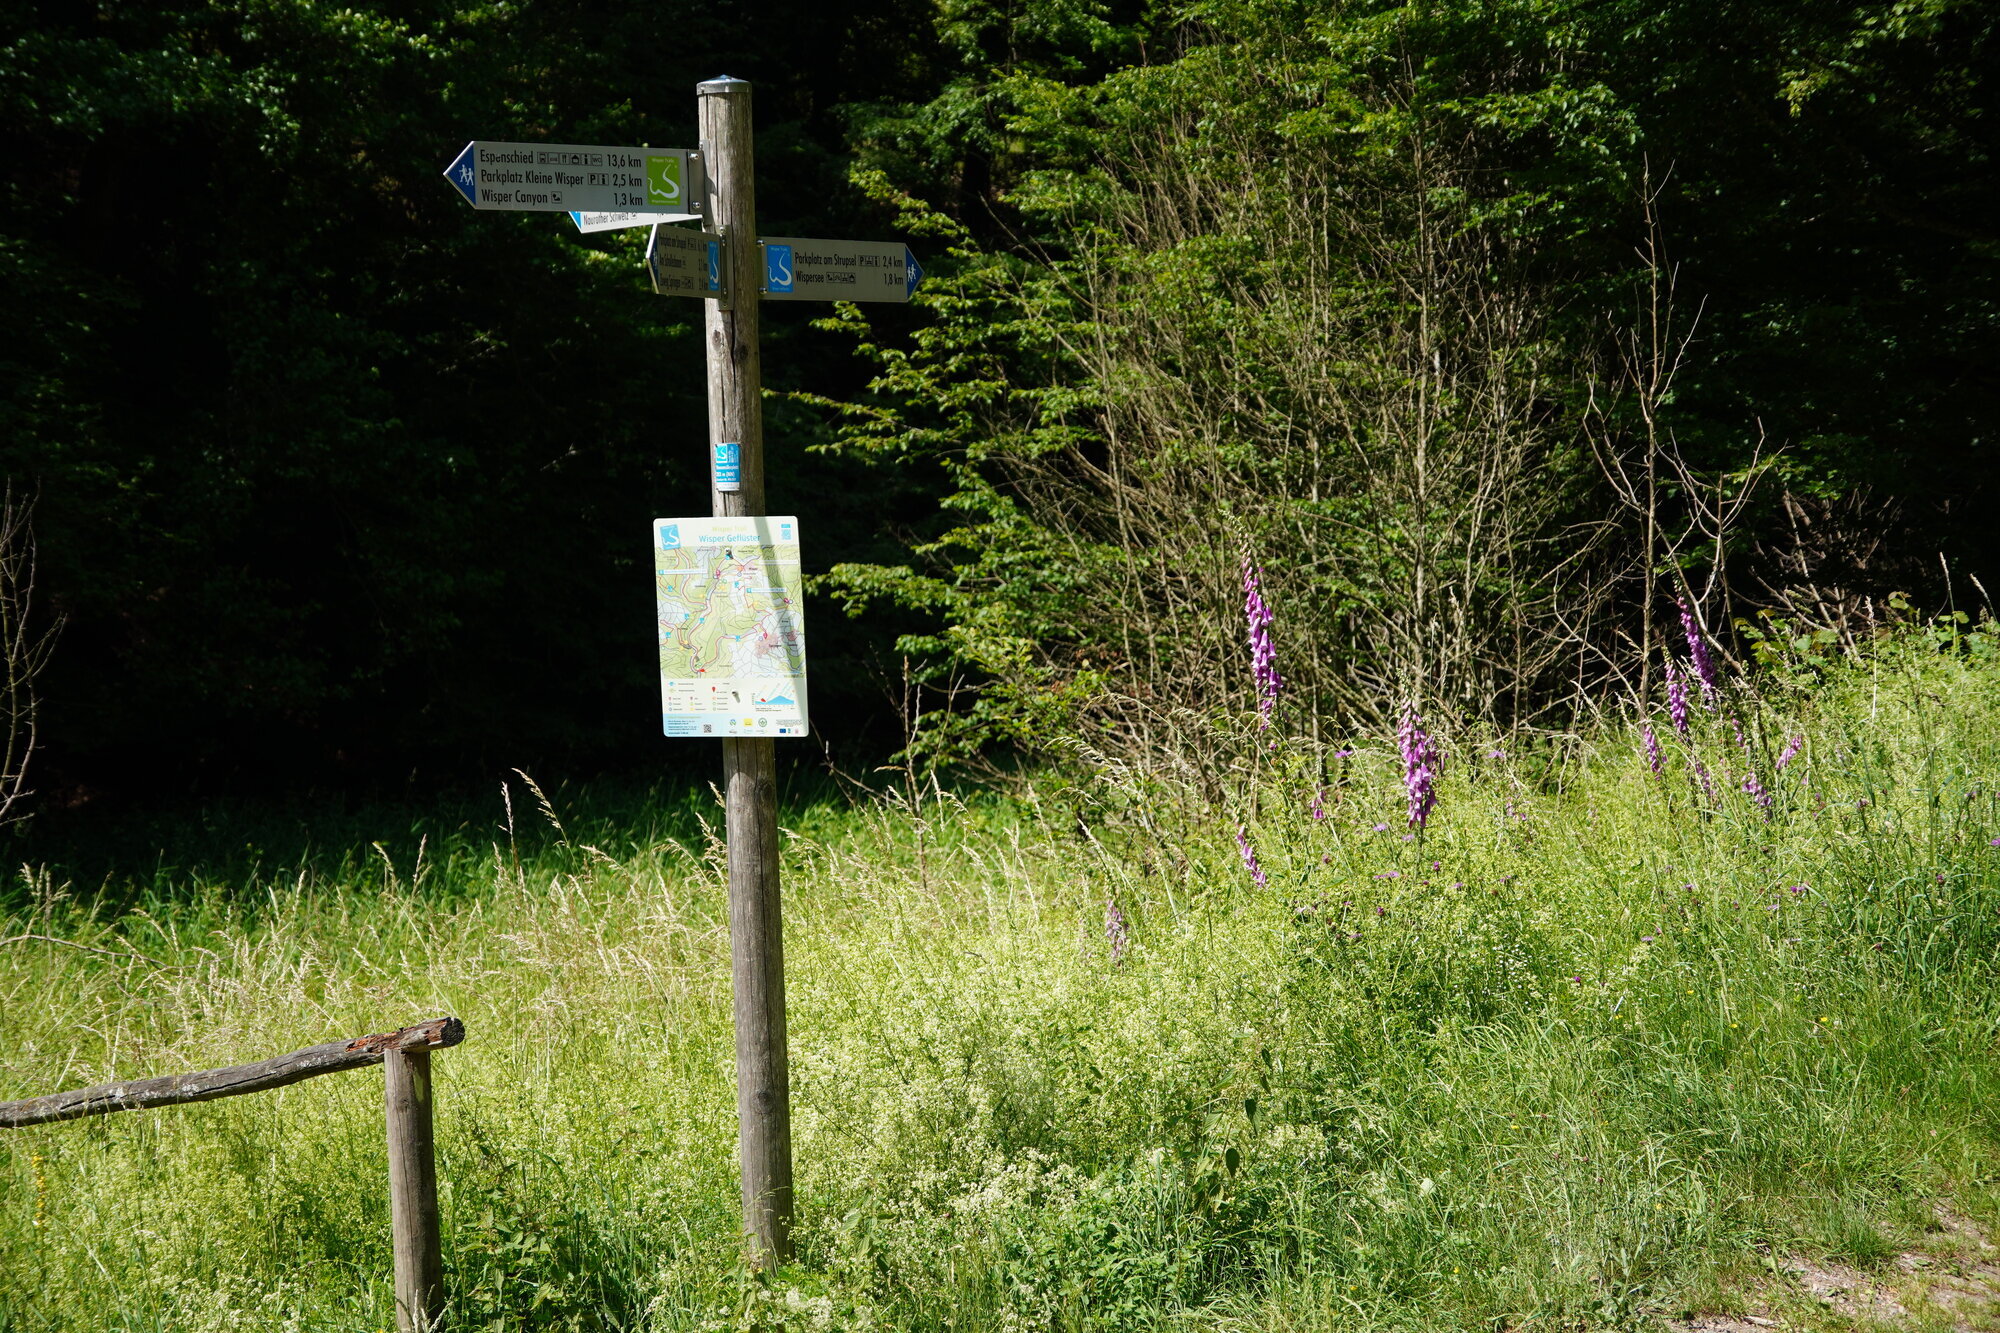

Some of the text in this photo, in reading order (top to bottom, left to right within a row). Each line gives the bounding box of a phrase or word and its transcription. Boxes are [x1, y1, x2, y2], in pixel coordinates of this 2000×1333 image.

[607, 154, 625, 168] 13,6
[628, 154, 642, 167] km
[481, 169, 523, 185] Parkplatz
[525, 171, 552, 184] Kleine
[555, 172, 584, 187] Wisper
[612, 173, 626, 188] 2,5
[629, 174, 642, 187] km
[481, 189, 643, 207] Wisper Canyon 1,3 km
[794, 252, 822, 267] Parkplatz
[823, 256, 833, 265] am
[834, 254, 857, 268] Strupsel
[882, 256, 892, 269] 2,4
[893, 256, 903, 268] km
[795, 272, 904, 286] Wispersee 1,8 km
[699, 535, 725, 543] Wisper
